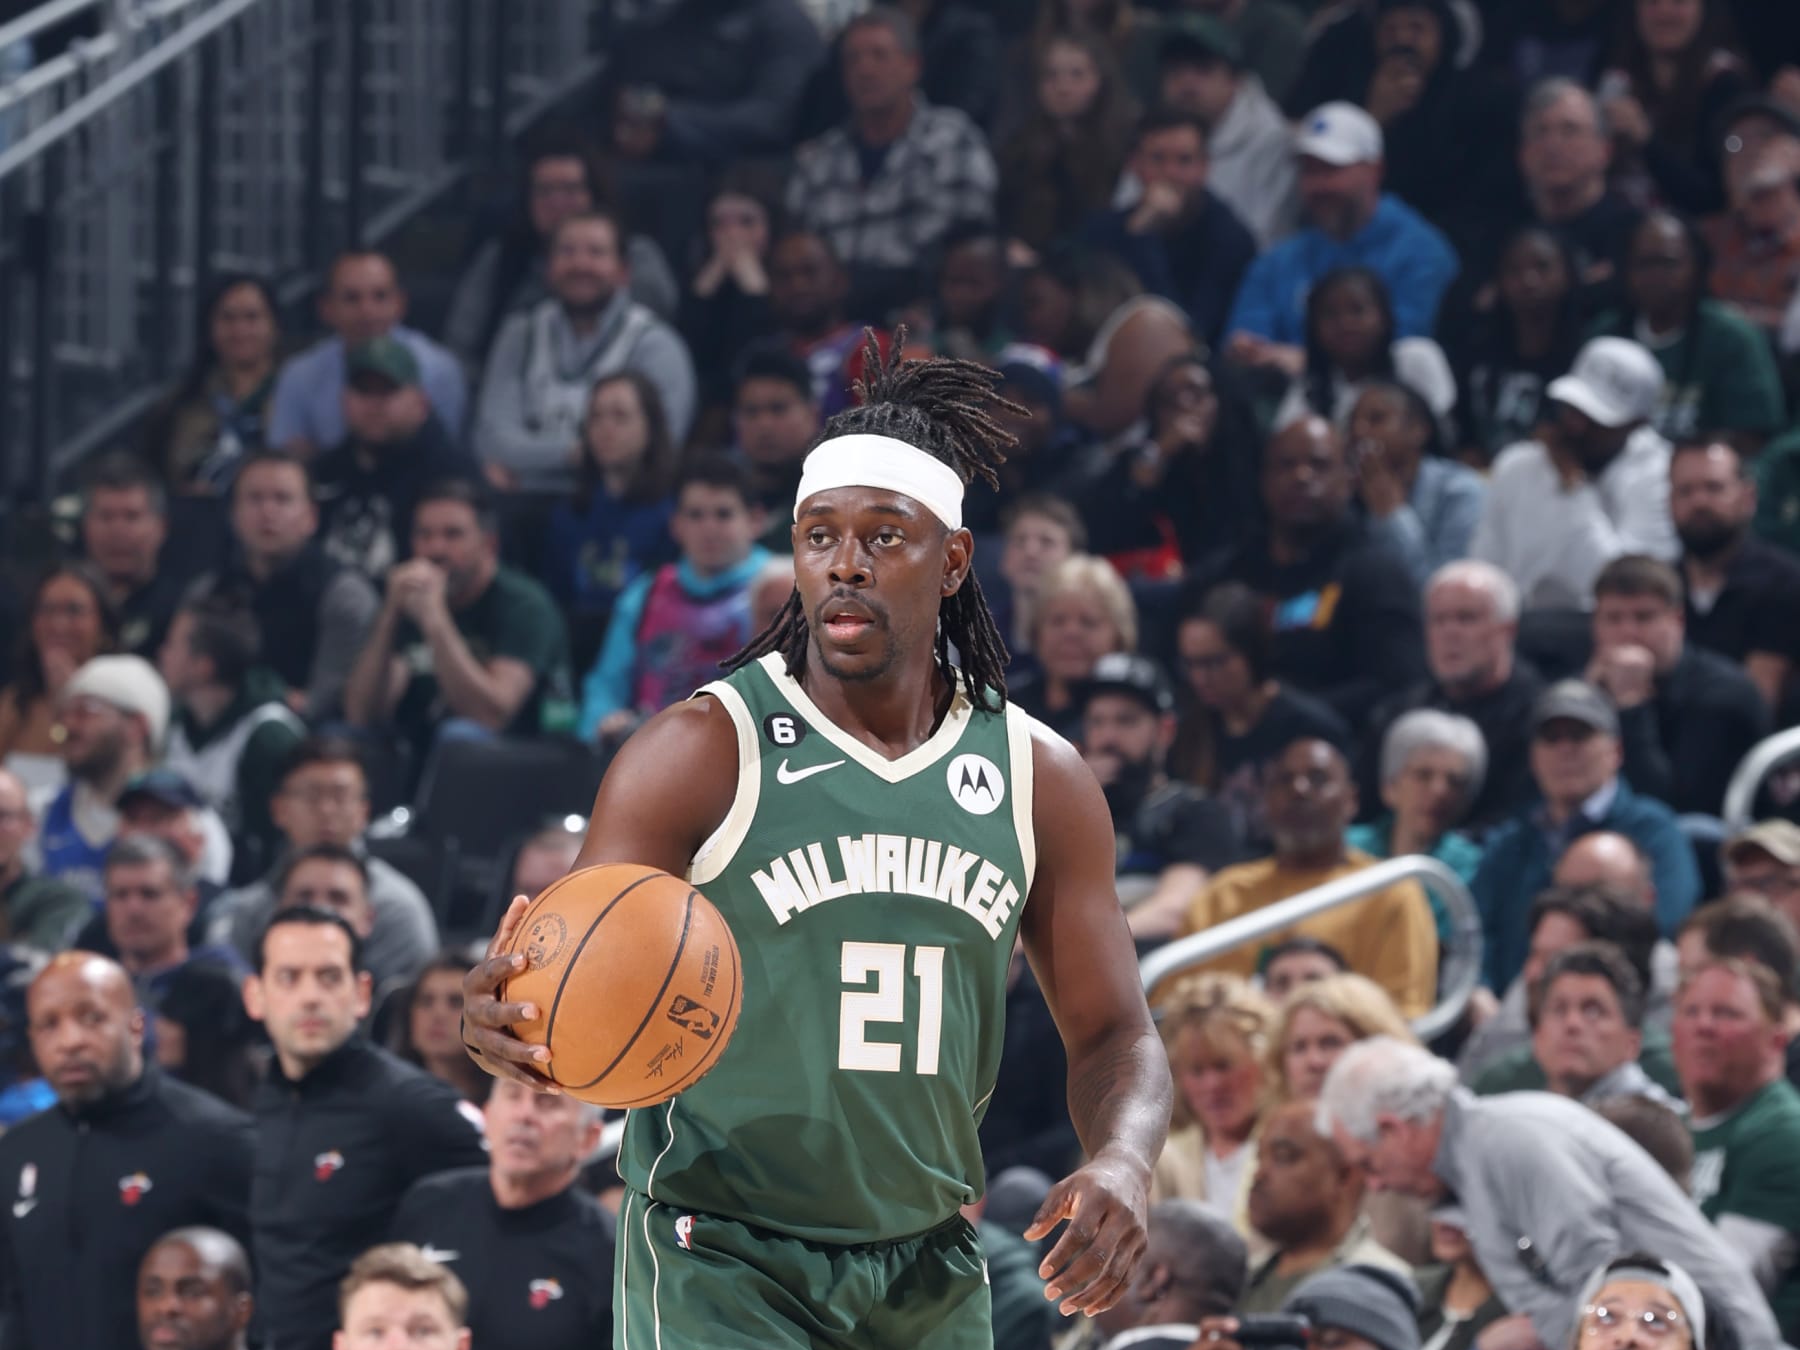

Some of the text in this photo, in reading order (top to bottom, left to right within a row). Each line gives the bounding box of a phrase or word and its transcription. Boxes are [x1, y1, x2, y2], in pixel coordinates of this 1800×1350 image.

[772, 718, 797, 745] 6
[750, 833, 1019, 940] MILWAUKEE
[839, 940, 945, 1075] 21
